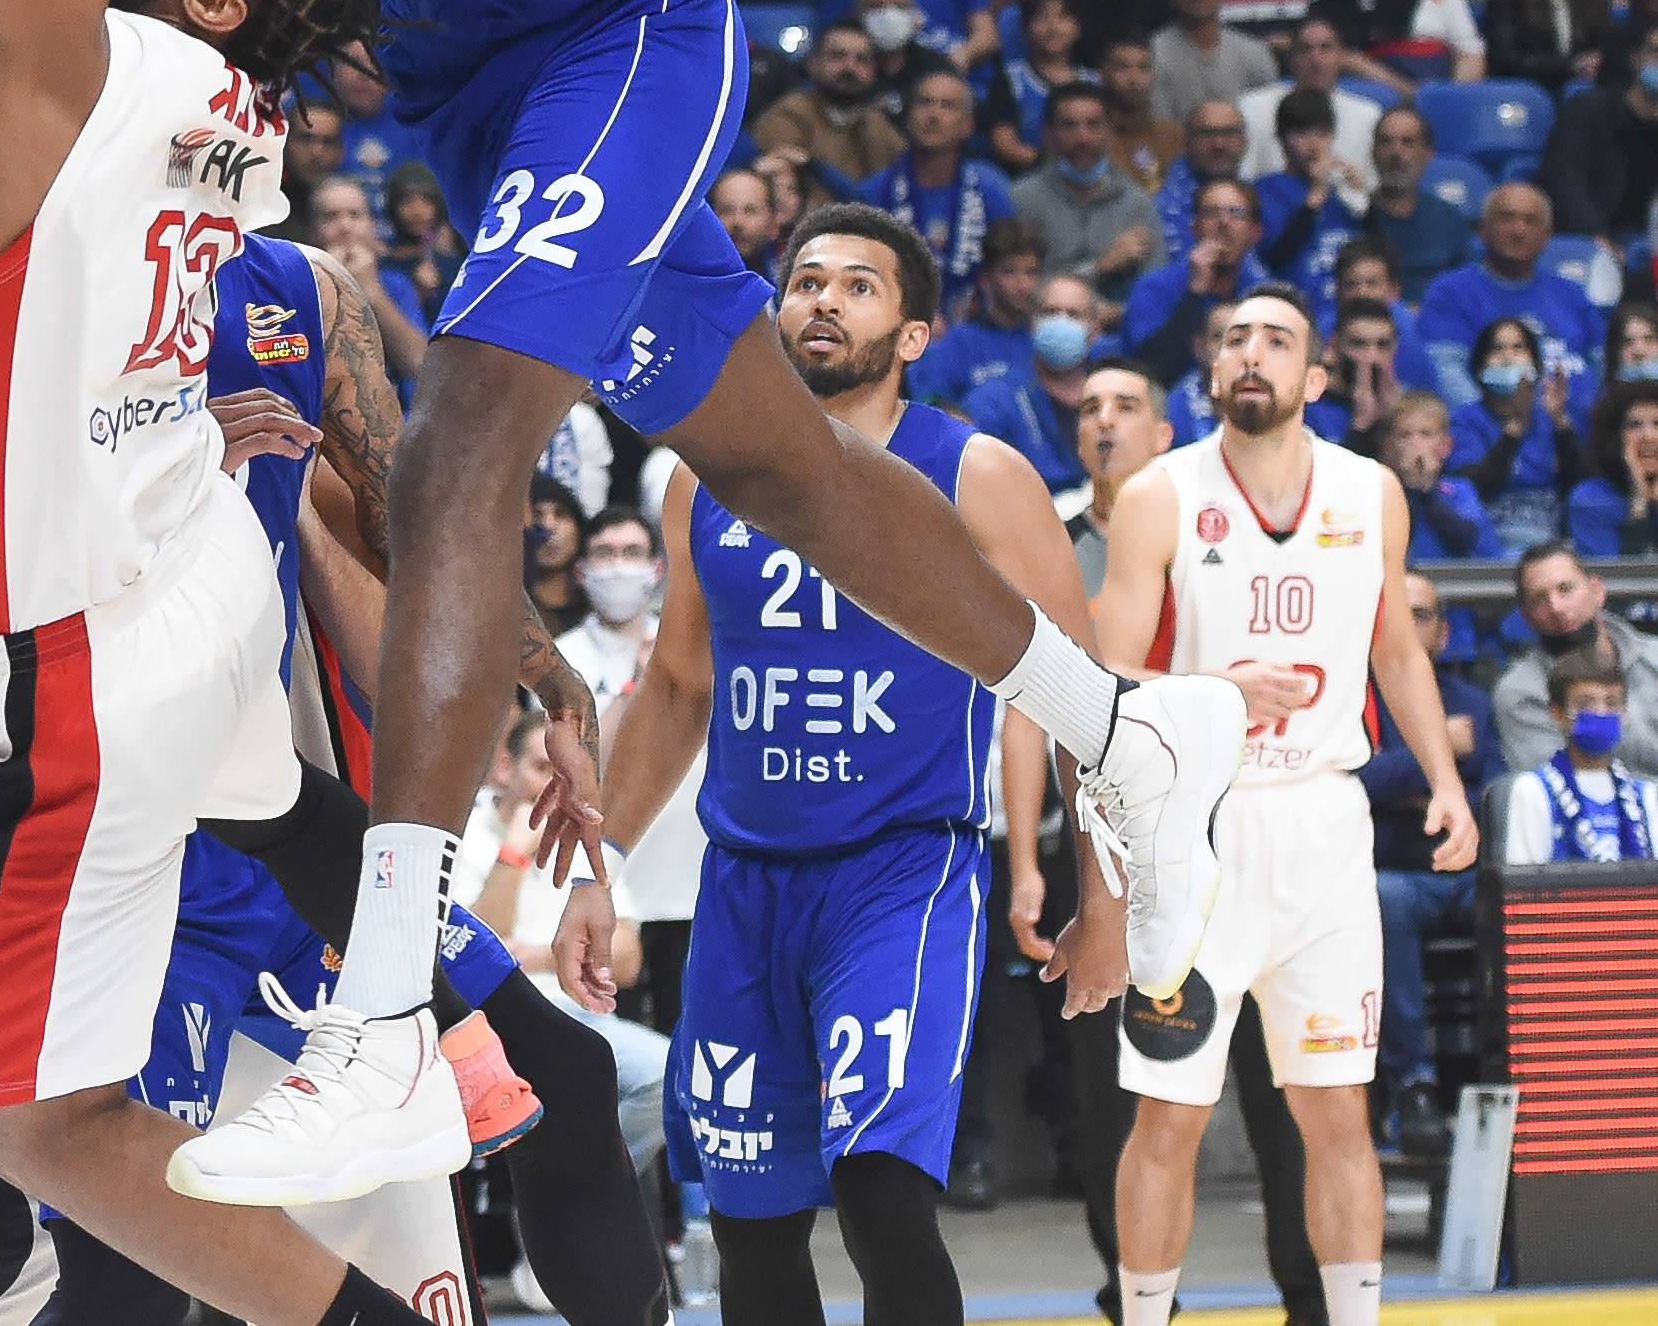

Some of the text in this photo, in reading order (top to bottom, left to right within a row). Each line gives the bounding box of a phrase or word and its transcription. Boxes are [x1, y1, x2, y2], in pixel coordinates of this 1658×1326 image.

[200, 139, 270, 203] AK
[474, 169, 605, 269] 32
[719, 532, 753, 548] PEAK
[1248, 575, 1314, 635] 10
[729, 665, 896, 735] OFEK
[762, 747, 865, 783] Dist.
[1241, 741, 1315, 771] etzer
[441, 923, 478, 962] PEAK
[828, 1007, 909, 1099] 21
[689, 1115, 773, 1161] יובלי
